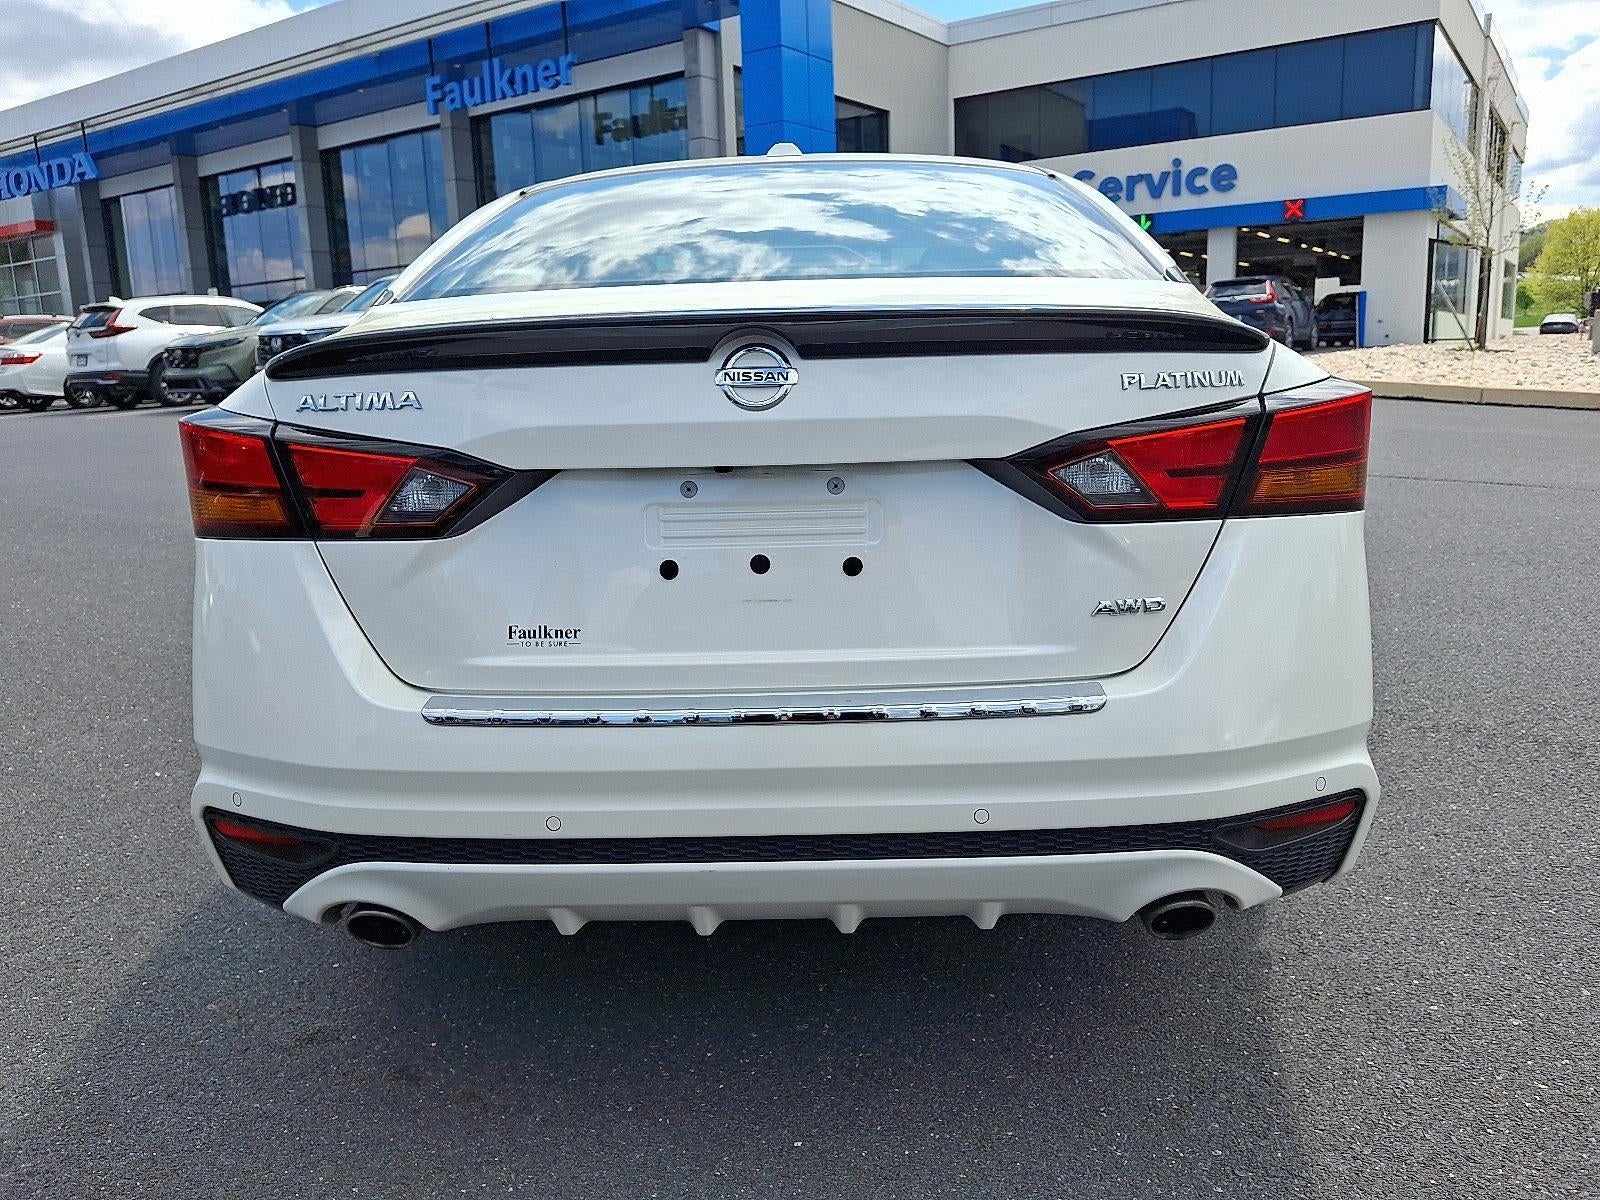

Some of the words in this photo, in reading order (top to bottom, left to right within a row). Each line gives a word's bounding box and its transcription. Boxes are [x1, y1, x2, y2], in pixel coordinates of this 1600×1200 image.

[425, 53, 578, 116] Faulkner
[723, 371, 789, 382] NISSAN
[1120, 369, 1245, 391] PLATINUM
[296, 390, 423, 412] ALTIMA
[1091, 596, 1167, 616] AWD
[508, 624, 582, 640] Faulkner
[521, 640, 532, 648] TO
[535, 640, 545, 648] BE
[548, 640, 568, 648] SURE
